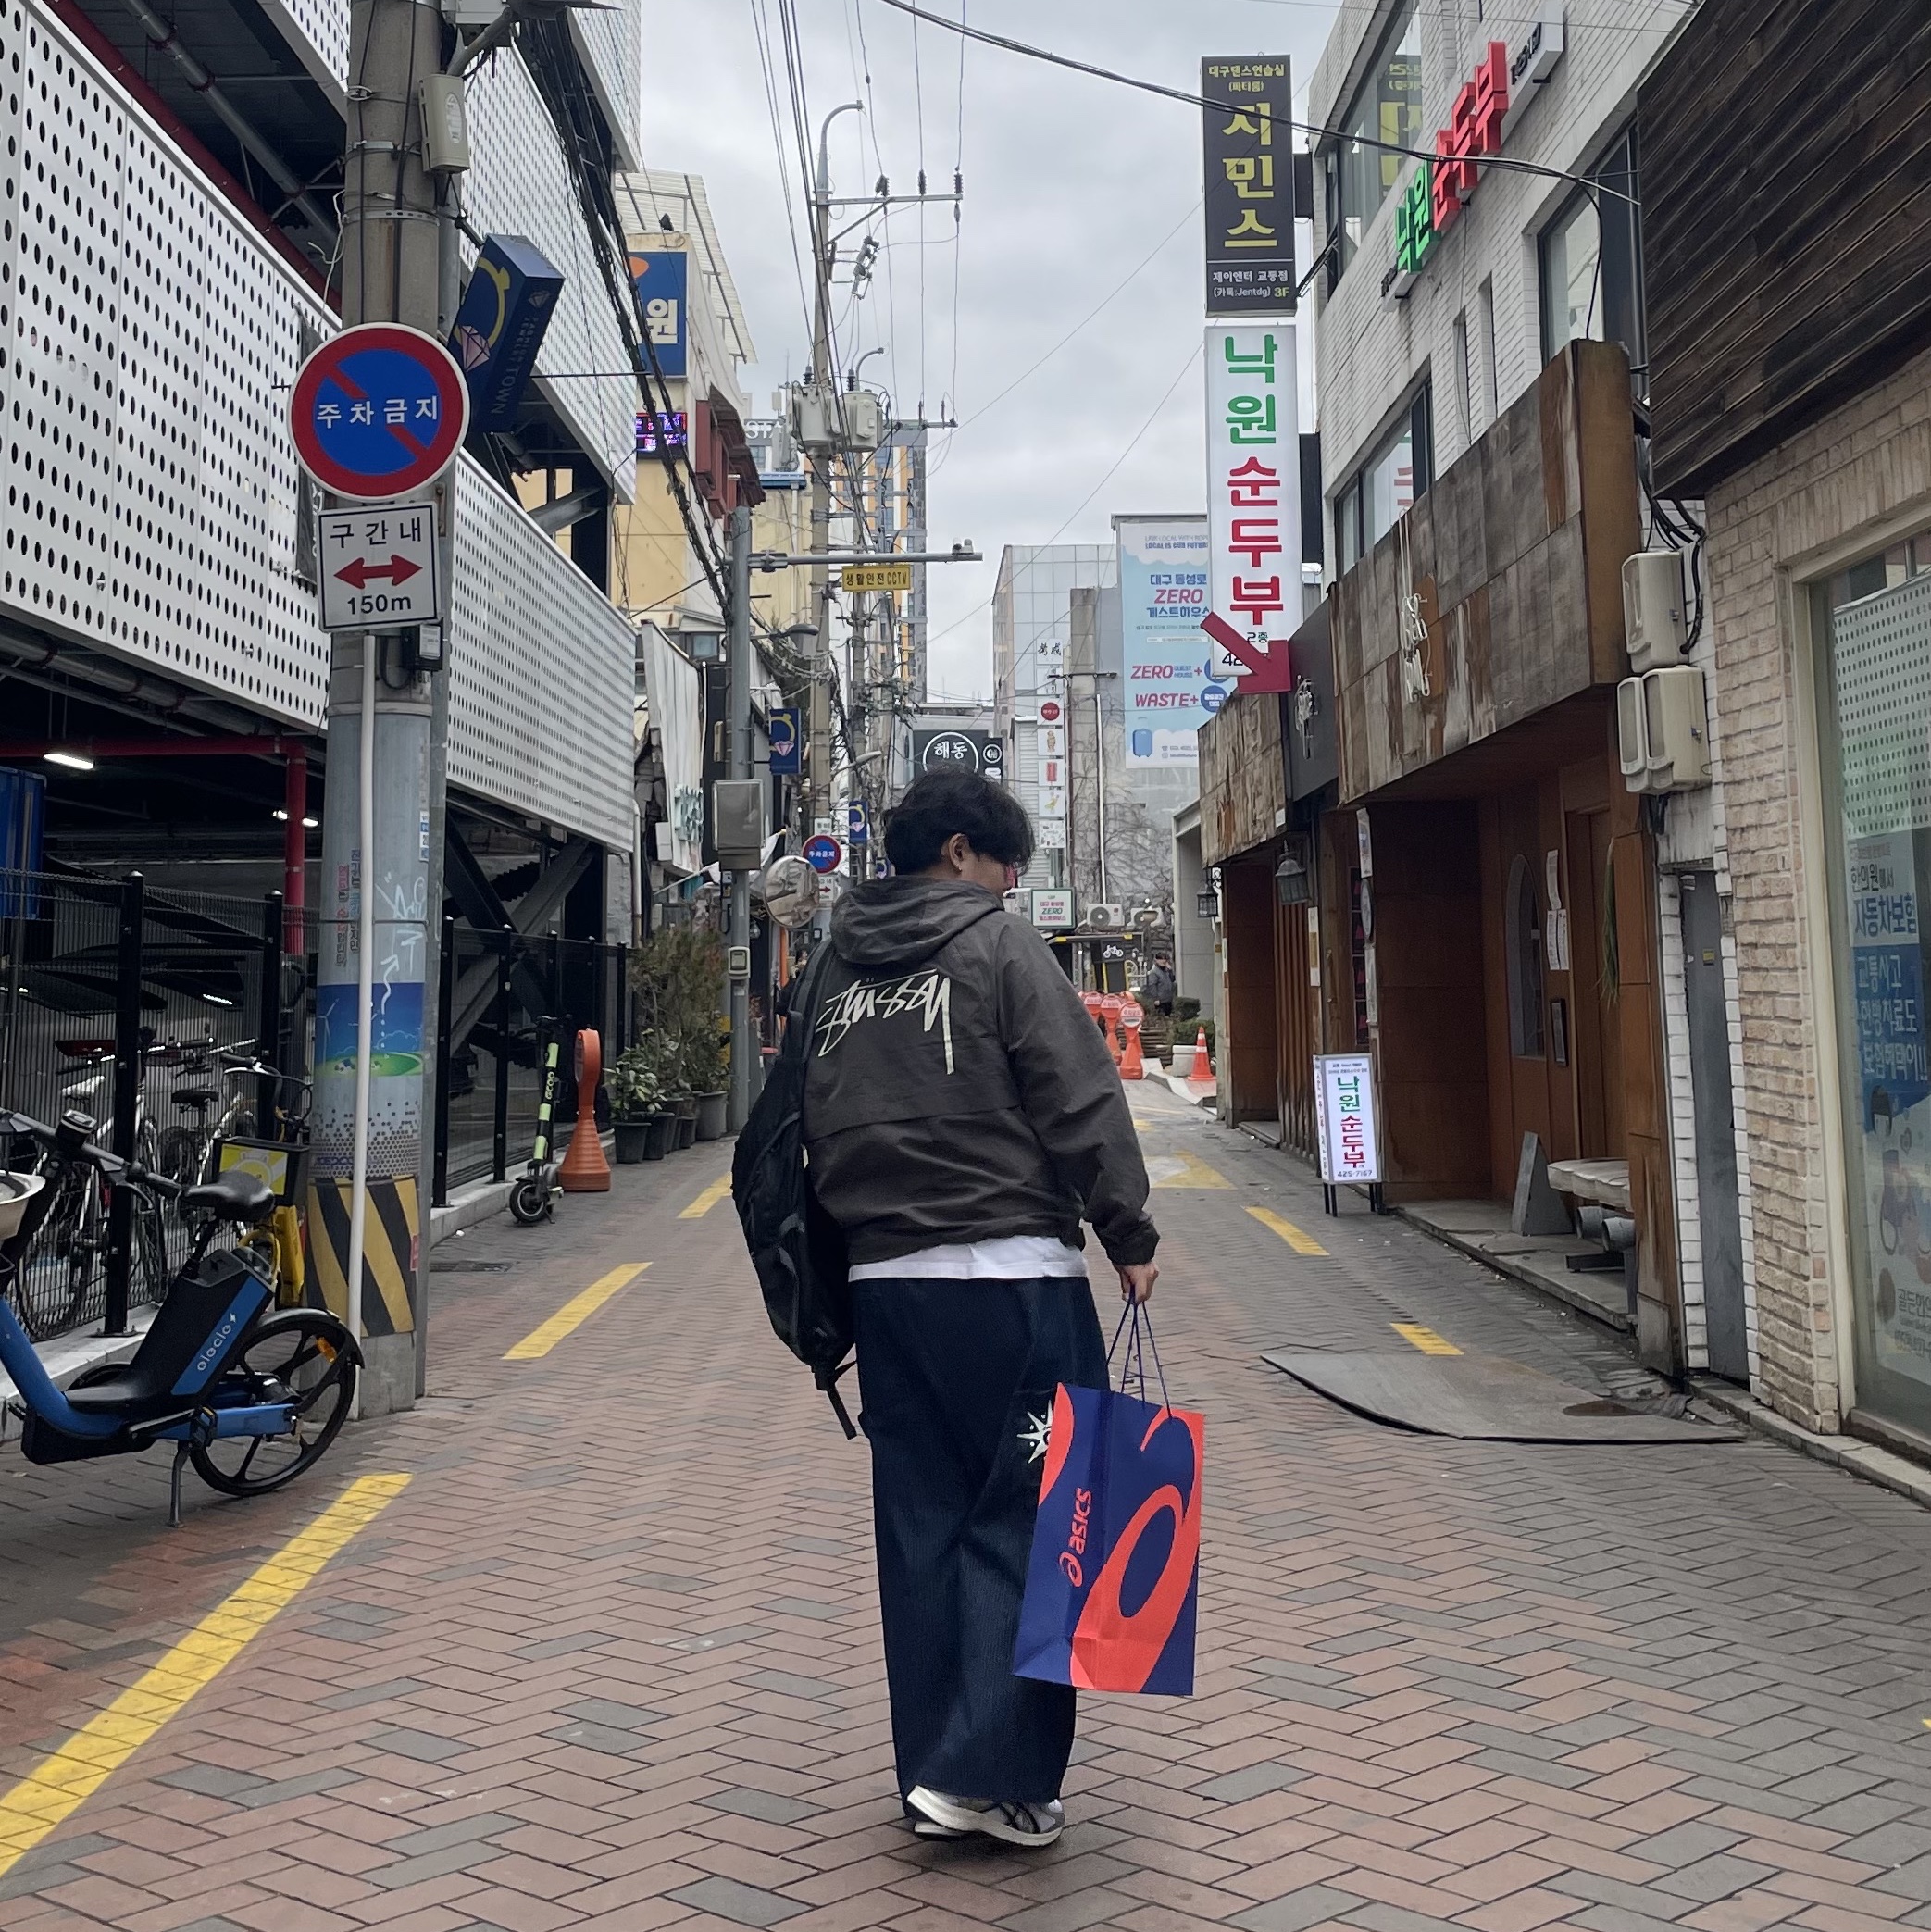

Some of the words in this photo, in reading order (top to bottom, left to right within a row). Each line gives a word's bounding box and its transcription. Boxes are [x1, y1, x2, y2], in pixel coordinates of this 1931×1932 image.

[1222, 102, 1277, 247] 지민스
[1274, 287, 1290, 297] 3F
[491, 368, 520, 415] TOWN
[317, 395, 439, 430] 주차금지
[1225, 334, 1284, 626] 낙원순두부
[330, 517, 422, 548] 구간내
[1150, 574, 1172, 585] 대구
[347, 593, 412, 616] 150m
[1154, 589, 1203, 604] ZERO
[1130, 665, 1173, 679] ZERO
[934, 741, 968, 759] 해동
[1854, 892, 1917, 938] 자동차보험
[1857, 954, 1902, 993] 교통사고
[1337, 1075, 1366, 1169] 낙원순두부
